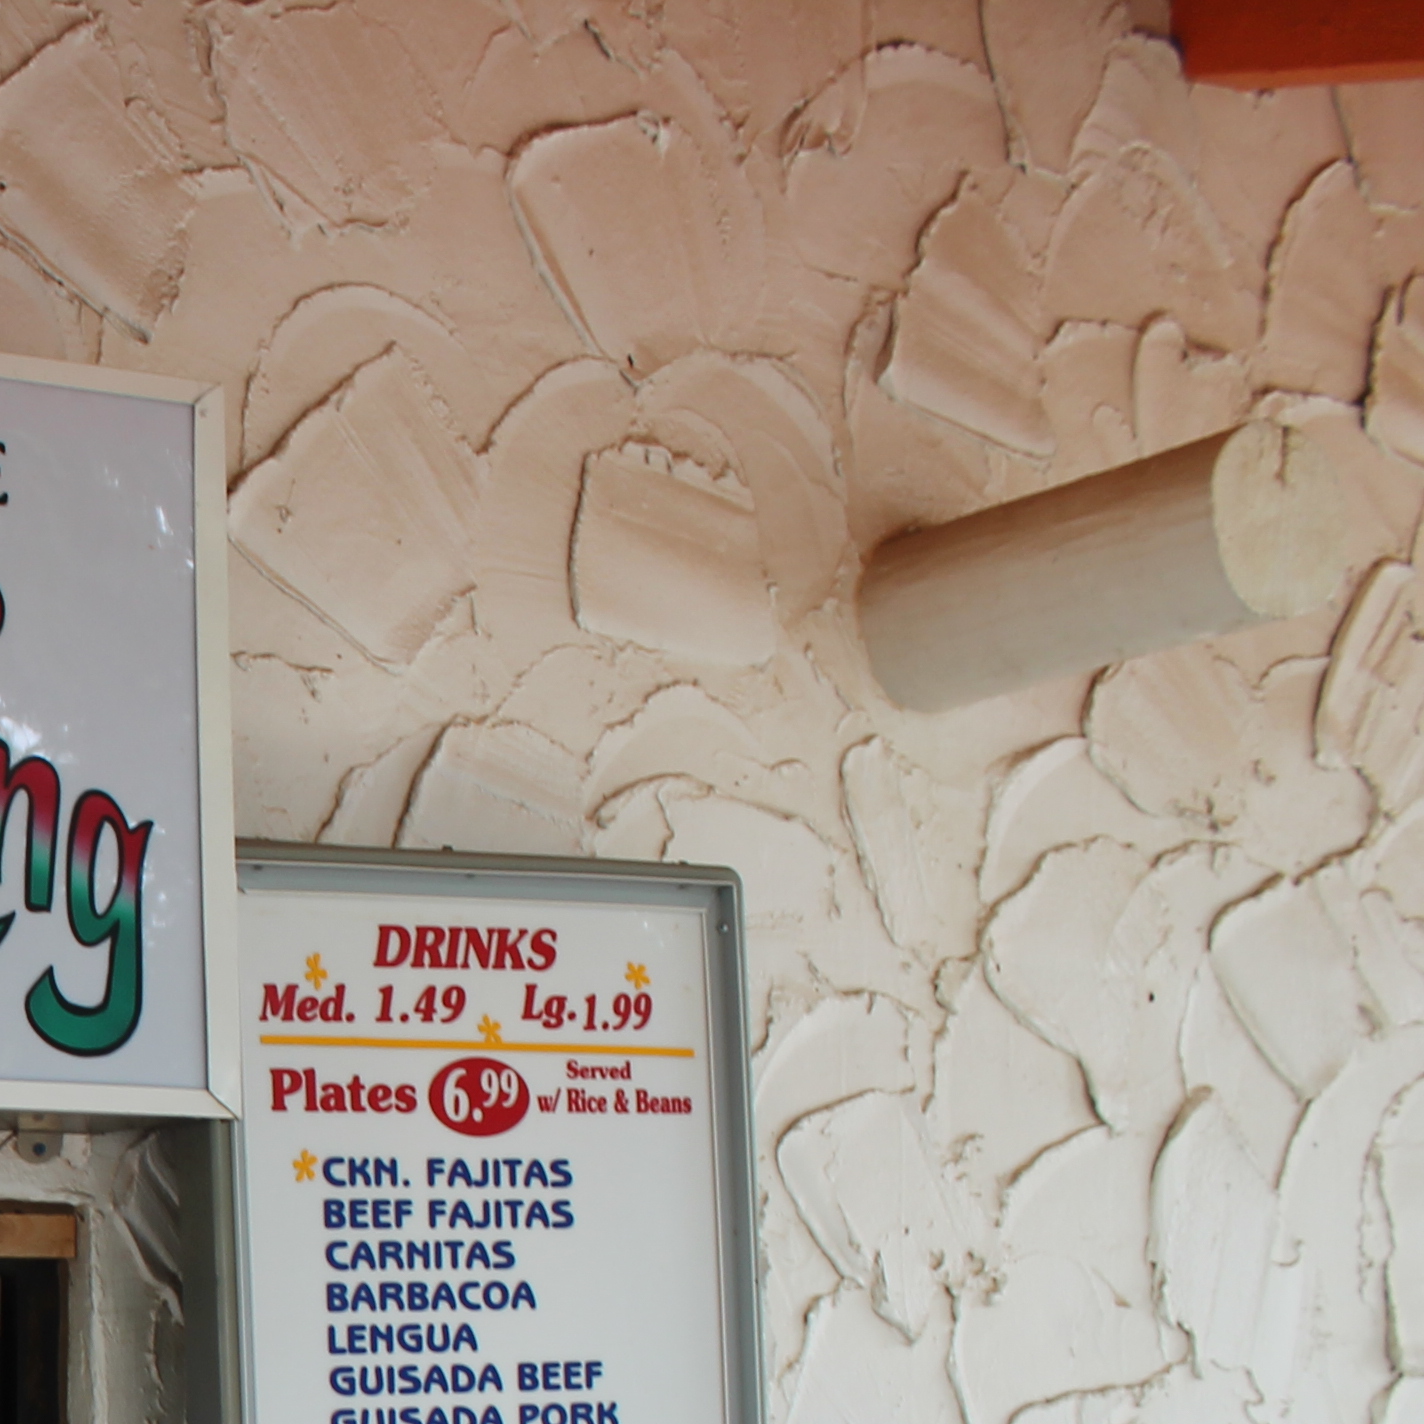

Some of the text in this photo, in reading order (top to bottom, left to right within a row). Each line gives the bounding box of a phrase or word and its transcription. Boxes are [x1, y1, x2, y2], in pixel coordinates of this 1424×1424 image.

[373, 924, 558, 972] DRINKS
[259, 983, 653, 1031] Med. 1.49 Lg. 1.99
[566, 1060, 632, 1080] Served
[269, 1068, 692, 1123] Plates 6.99 w/ Rice & Beans
[324, 1155, 574, 1189] CKN. FAJITAS
[329, 1322, 479, 1356] LENGUA
